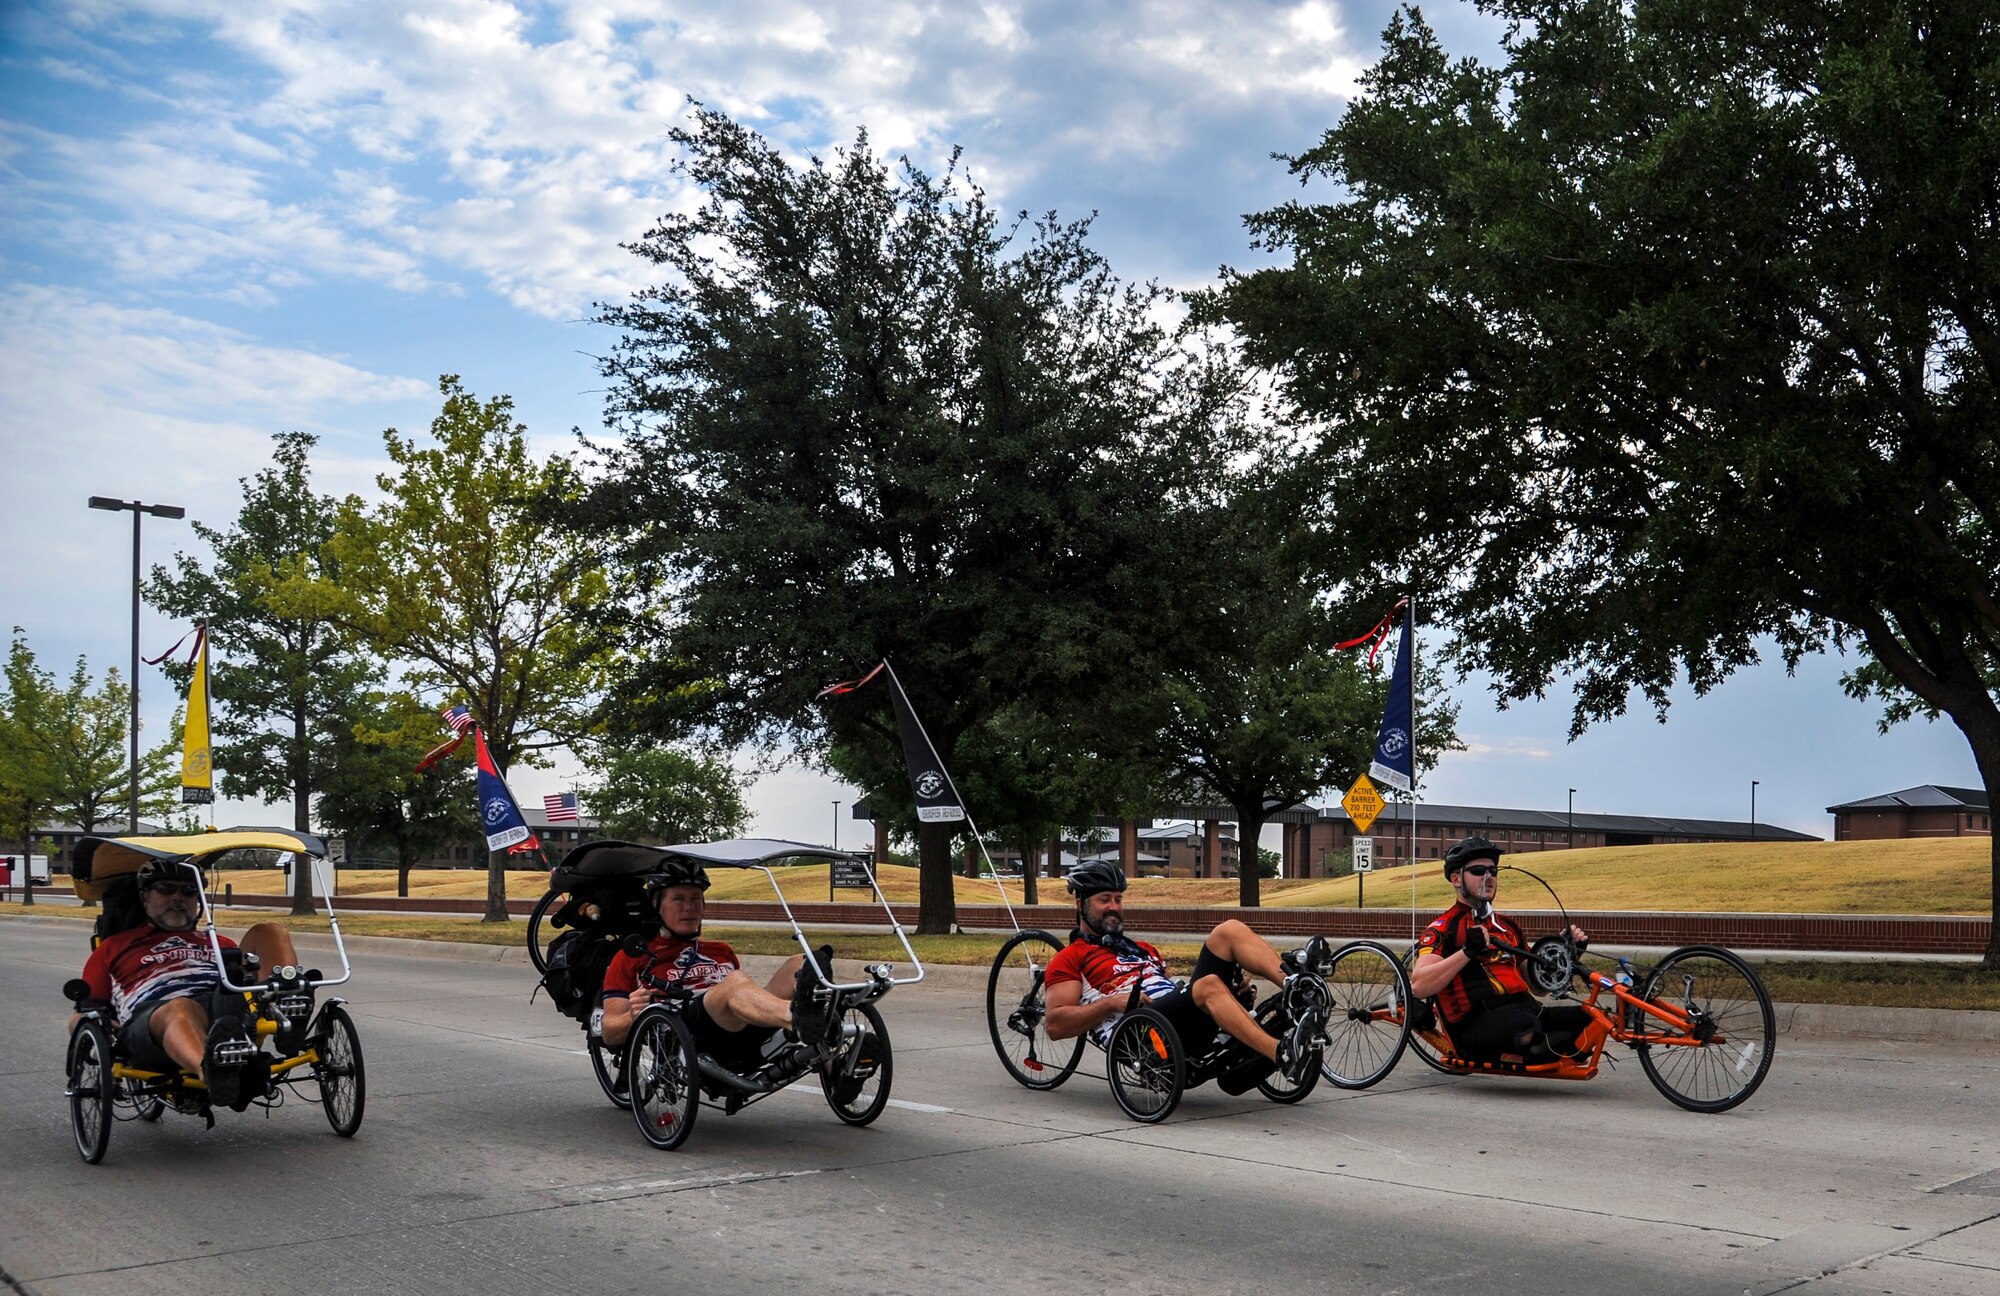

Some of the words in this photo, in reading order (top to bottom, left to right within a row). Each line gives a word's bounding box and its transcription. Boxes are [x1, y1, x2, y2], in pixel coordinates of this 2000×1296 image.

[1353, 787, 1373, 796] ACTIVE
[1351, 795, 1376, 804] BARRIER
[1350, 804, 1360, 812] 210
[1362, 804, 1377, 812] FEET
[1353, 812, 1373, 820] AHEAD
[1356, 855, 1369, 869] 15
[666, 964, 717, 981] SEMPER
